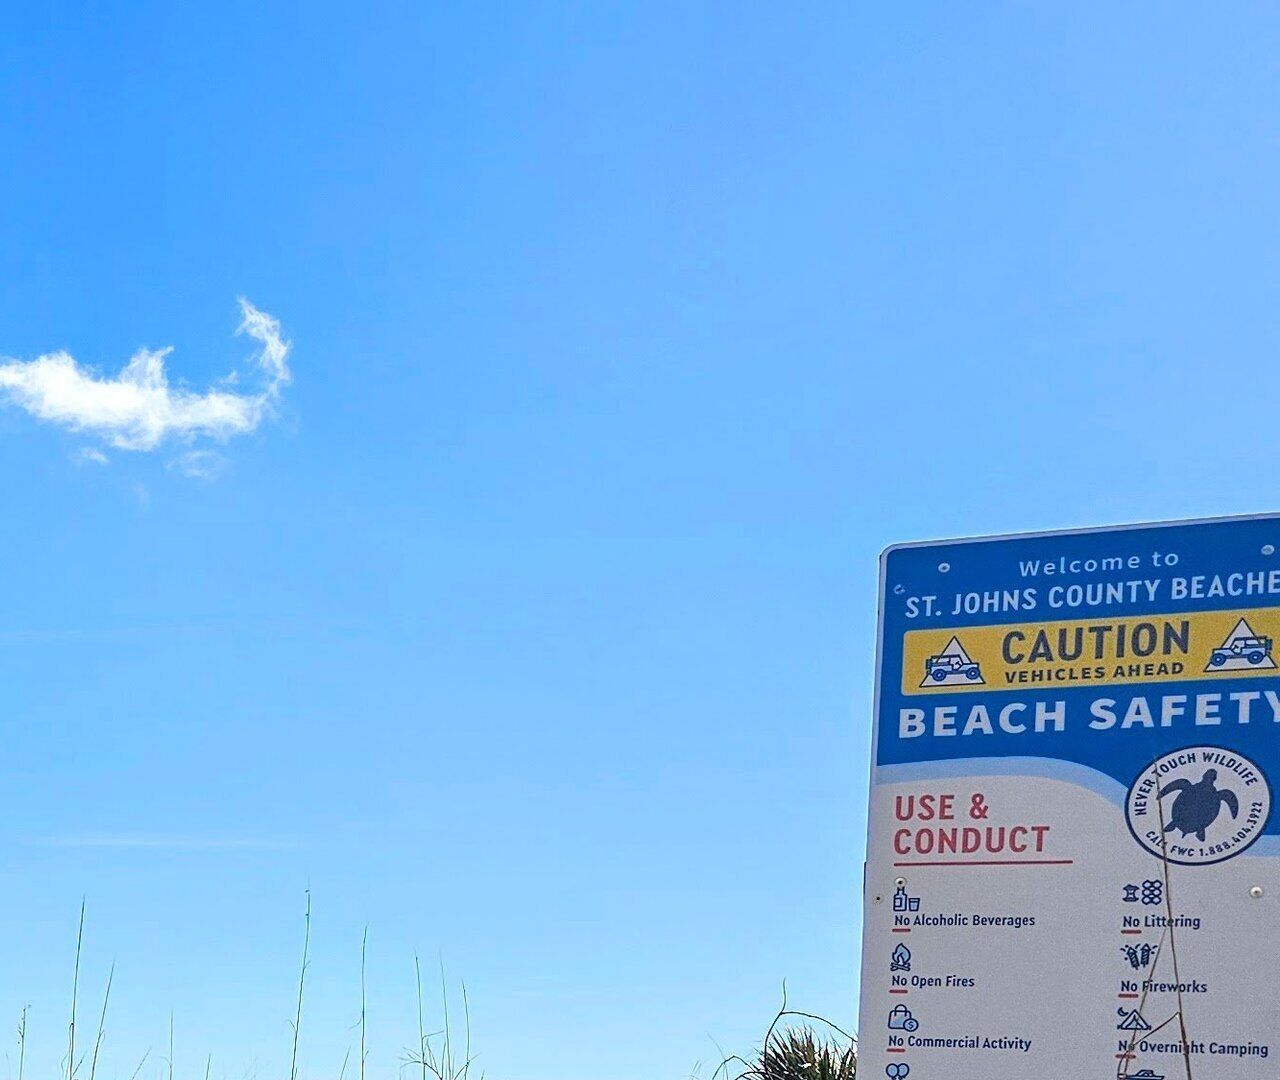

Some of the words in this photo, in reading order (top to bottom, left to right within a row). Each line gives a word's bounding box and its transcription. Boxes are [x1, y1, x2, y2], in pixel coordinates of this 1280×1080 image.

[1019, 554, 1140, 577] Welcome
[1151, 551, 1179, 567] to
[905, 595, 942, 618] ST.
[952, 588, 1037, 616] JOHNS
[1048, 579, 1161, 609] COUNTY
[1001, 620, 1190, 665] CAUTION
[1005, 666, 1105, 684] VEHICLES
[1113, 661, 1184, 680] AHEAD
[898, 701, 1066, 738] BEACH
[1089, 690, 1280, 730] SAFETY
[1134, 778, 1156, 816] NEVER
[1151, 752, 1196, 778] TOUCH
[1202, 752, 1258, 786] WILDLIFE
[895, 794, 955, 821] USE
[969, 793, 989, 820] &
[893, 826, 1050, 854] CONDUCT
[1170, 845, 1194, 857] FWC
[1199, 801, 1263, 857] 1.888.404.3922
[894, 914, 910, 926] No
[913, 914, 968, 926] Alcoholic
[972, 914, 1035, 929] Beverages
[1123, 916, 1140, 928] No
[1145, 914, 1201, 930] Littering
[892, 975, 907, 986] No
[911, 976, 941, 989] Open
[946, 975, 975, 987] Fires
[1121, 980, 1137, 992] No
[1142, 979, 1207, 993] Fireworks
[888, 1035, 904, 1047] No
[908, 1035, 979, 1049] Commercial
[982, 1036, 1032, 1052] Activity
[1140, 1040, 1205, 1054] Overniht
[1209, 1042, 1269, 1058] Camping
